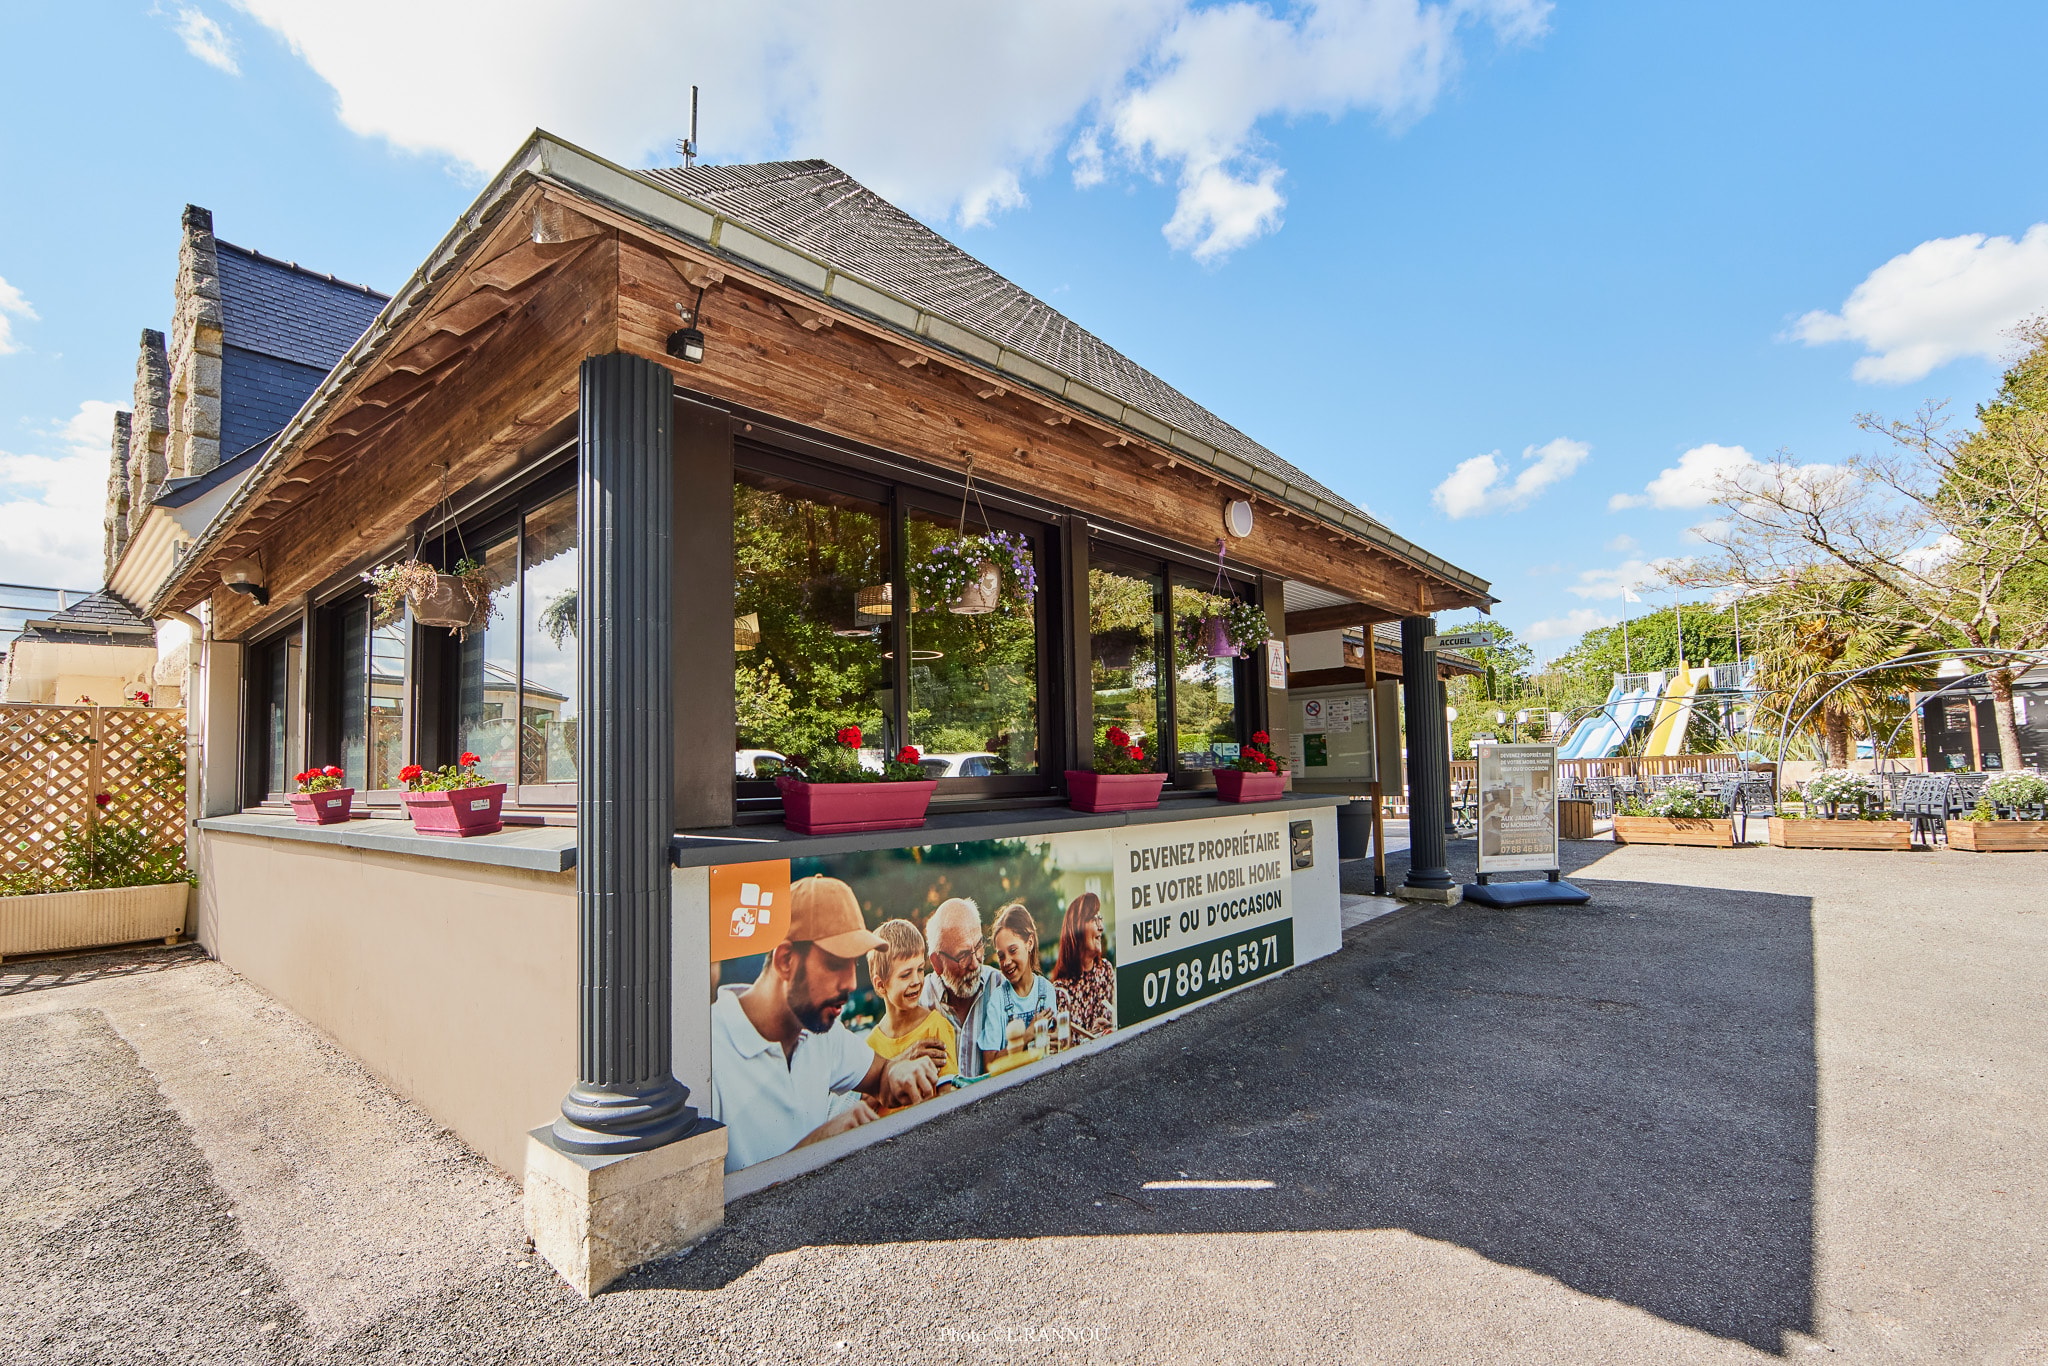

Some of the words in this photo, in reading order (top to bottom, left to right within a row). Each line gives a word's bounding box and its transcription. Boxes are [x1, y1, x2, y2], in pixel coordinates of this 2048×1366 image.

[1440, 637, 1472, 646] ACCUEIL
[1130, 842, 1195, 873] DEVENEZ
[1198, 829, 1280, 862] PROPRIÉTAIRE
[1501, 846, 1510, 854] 07
[1131, 886, 1151, 910] DE
[1155, 874, 1203, 904] VOTRE
[1206, 867, 1245, 894] MOBIL
[1249, 861, 1281, 885] HOME
[1132, 915, 1171, 946] NEUF
[1179, 908, 1200, 933] OU
[1207, 890, 1282, 927] D'OCCASION
[1143, 968, 1171, 1008] 07
[1176, 959, 1203, 997] 88
[1207, 949, 1233, 985] 46
[1237, 941, 1259, 975] 53
[1262, 934, 1278, 967] 71
